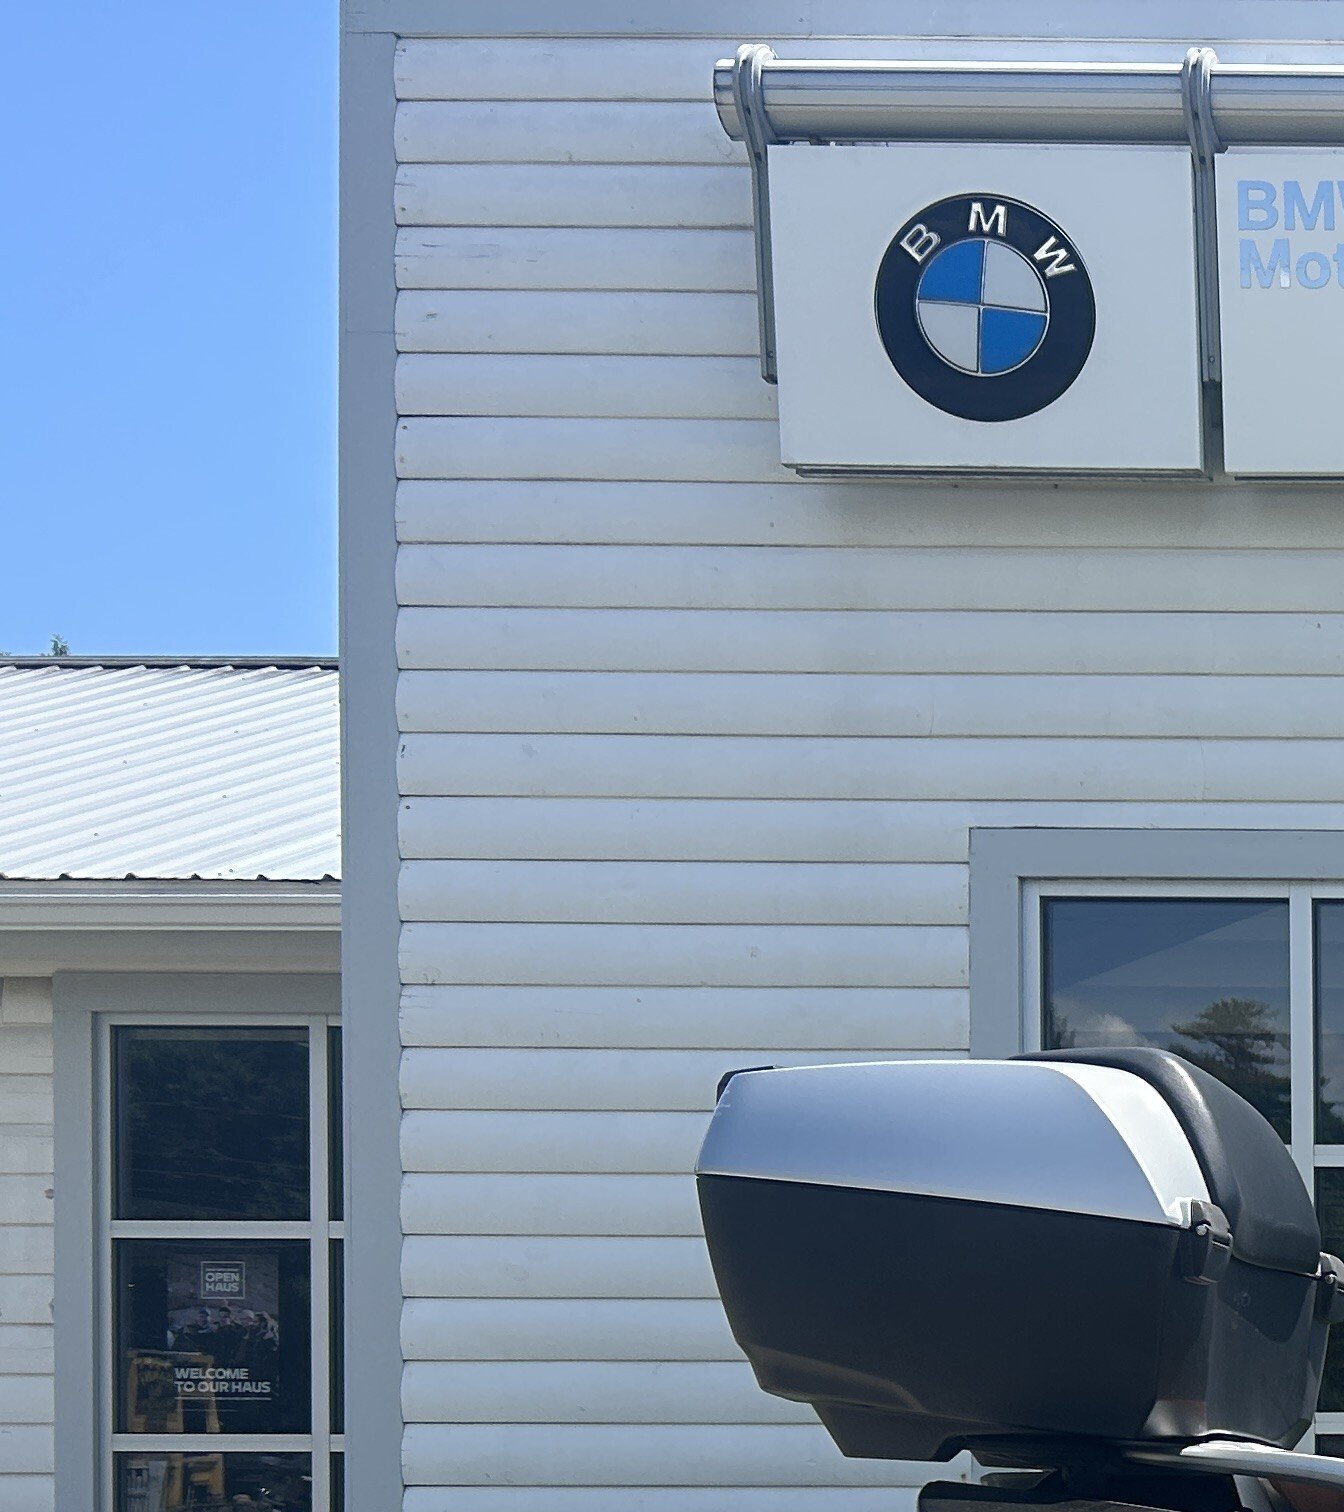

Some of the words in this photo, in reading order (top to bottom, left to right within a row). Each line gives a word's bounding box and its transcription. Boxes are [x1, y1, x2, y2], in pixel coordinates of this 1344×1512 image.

[900, 202, 1078, 279] BMW
[205, 1272, 240, 1282] OPEN
[205, 1282, 240, 1292] HAUS
[174, 1367, 249, 1380] WELCOME
[174, 1381, 196, 1393] TO
[197, 1381, 230, 1393] OUR
[231, 1381, 271, 1393] HAUS
